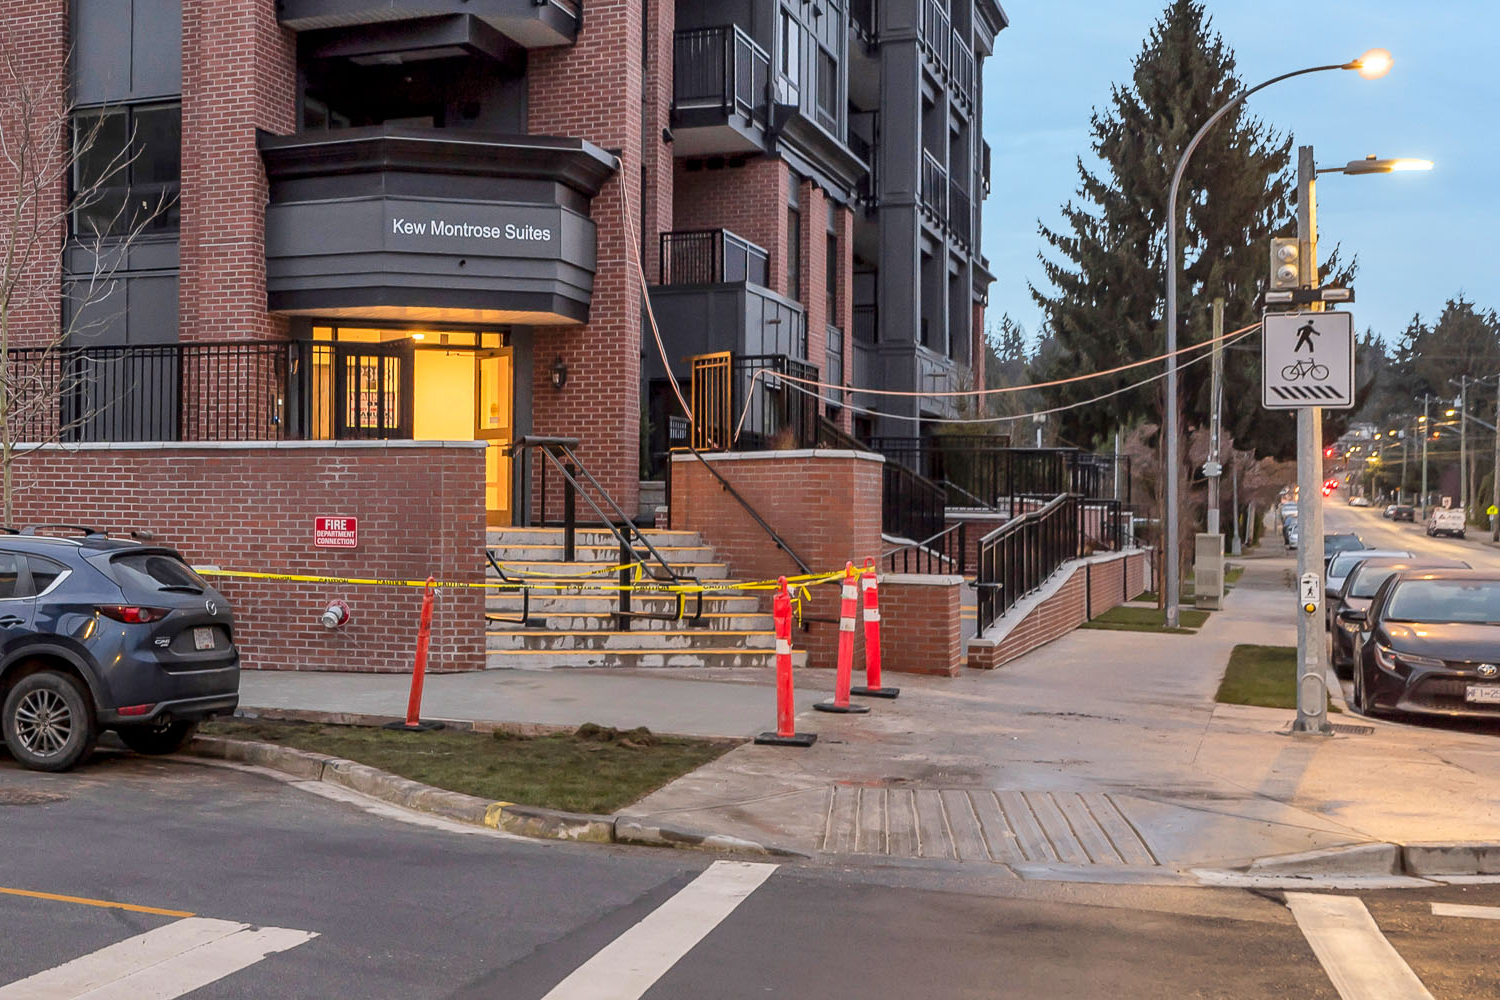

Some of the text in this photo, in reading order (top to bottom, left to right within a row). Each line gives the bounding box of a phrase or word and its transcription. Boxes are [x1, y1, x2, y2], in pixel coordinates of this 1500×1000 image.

[393, 218, 551, 241] Kew Montrose Suites
[325, 519, 347, 530] FIRE
[316, 530, 355, 538] DEPARTMENT
[316, 537, 355, 545] CONNECTION
